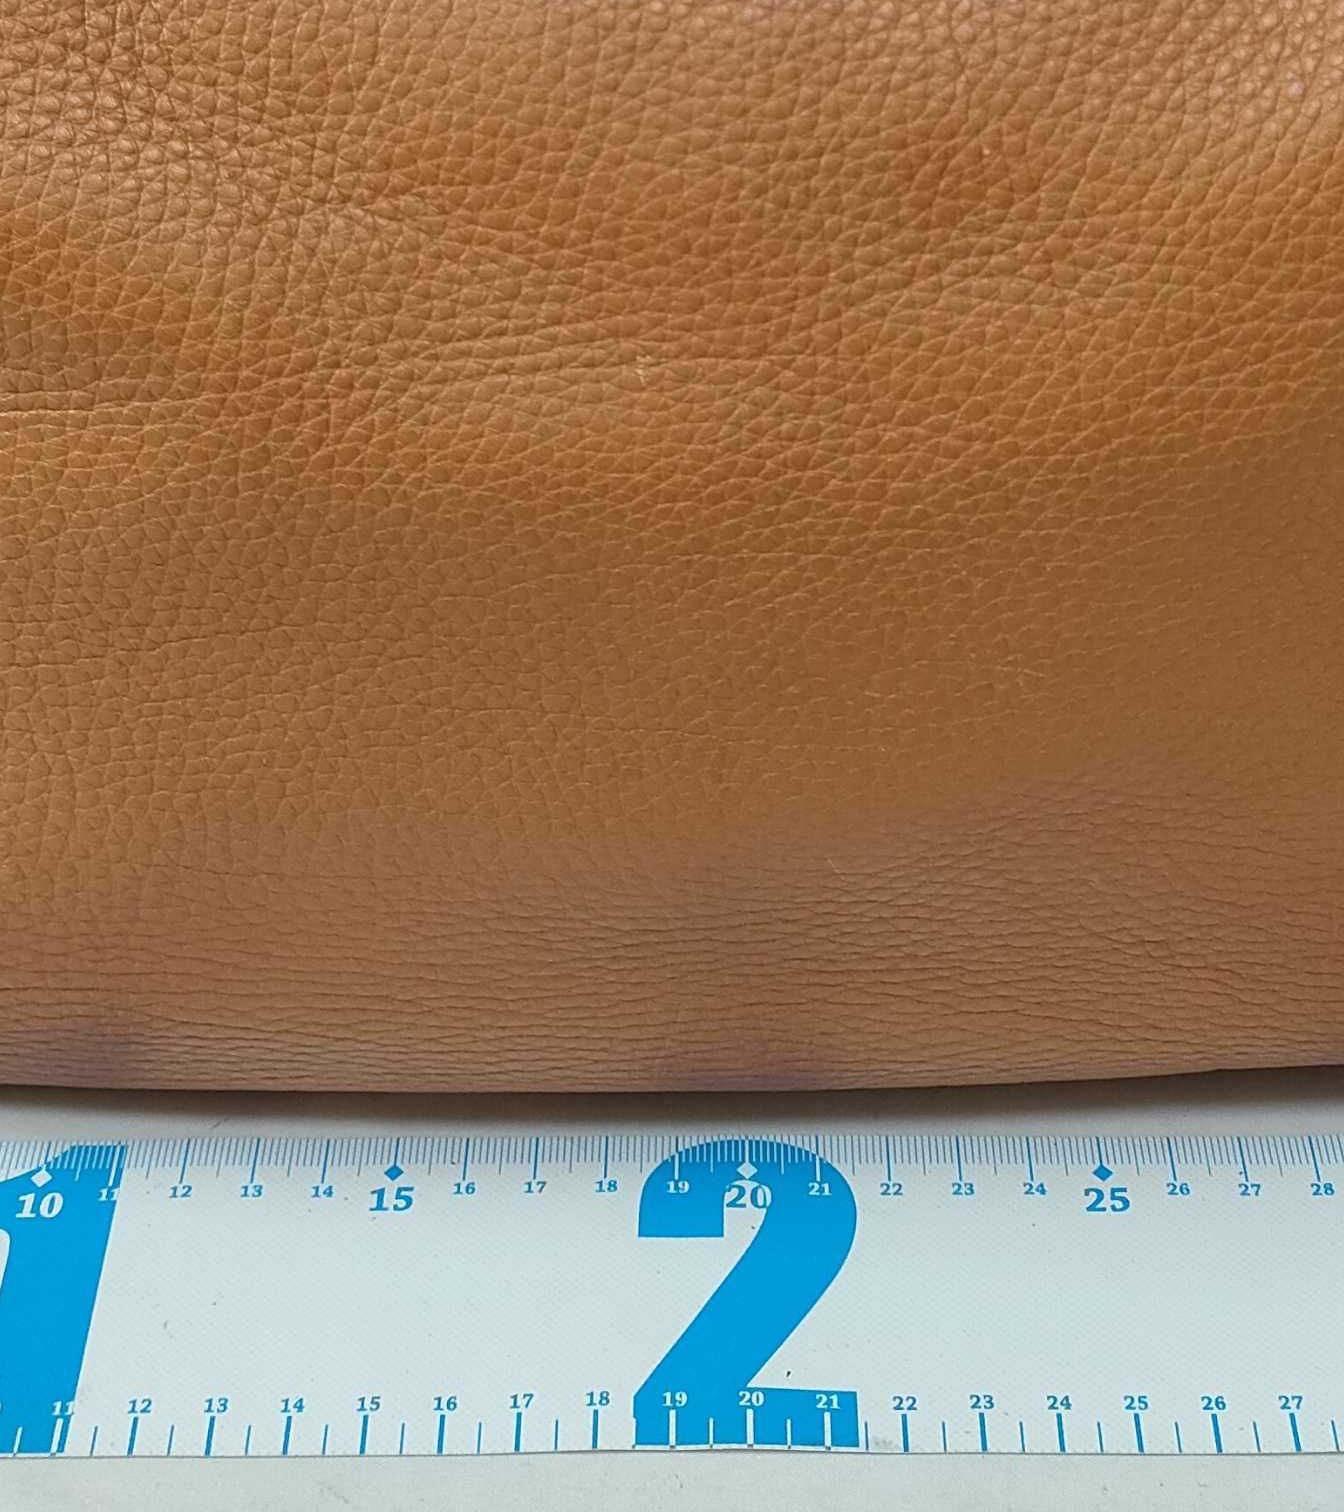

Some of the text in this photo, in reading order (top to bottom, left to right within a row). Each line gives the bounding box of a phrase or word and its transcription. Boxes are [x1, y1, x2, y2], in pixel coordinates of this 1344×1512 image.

[15, 1194, 63, 1218] 10
[96, 1187, 120, 1202] 11
[169, 1185, 193, 1199] 12
[240, 1185, 264, 1198] 13
[311, 1185, 335, 1199] 14
[368, 1186, 415, 1213] 15
[452, 1182, 477, 1195] 16
[524, 1181, 547, 1194] 17
[595, 1180, 618, 1193] 18
[666, 1181, 691, 1194] 19
[724, 1184, 771, 1209] 20
[807, 1182, 832, 1196] 21
[879, 1183, 904, 1196] 22
[951, 1183, 975, 1196] 23
[1023, 1182, 1047, 1196] 24
[1084, 1187, 1130, 1213] 25
[1166, 1183, 1190, 1196] 26
[1238, 1184, 1262, 1197] 27
[1311, 1182, 1335, 1197] 28
[634, 1139, 860, 1447] 2
[52, 1401, 76, 1417] 11
[127, 1398, 152, 1414] 12
[203, 1399, 229, 1413] 13
[280, 1398, 305, 1413] 14
[356, 1396, 382, 1411] 15
[433, 1396, 458, 1410] 16
[510, 1394, 534, 1409] 17
[585, 1391, 611, 1406] 18
[662, 1391, 688, 1407] 19
[739, 1390, 765, 1406] 20
[815, 1394, 841, 1409] 21
[892, 1396, 918, 1410] 22
[969, 1395, 995, 1410] 23
[1046, 1395, 1072, 1410] 24
[1123, 1395, 1150, 1410] 25
[1201, 1395, 1227, 1410] 26
[1277, 1395, 1304, 1410] 27
